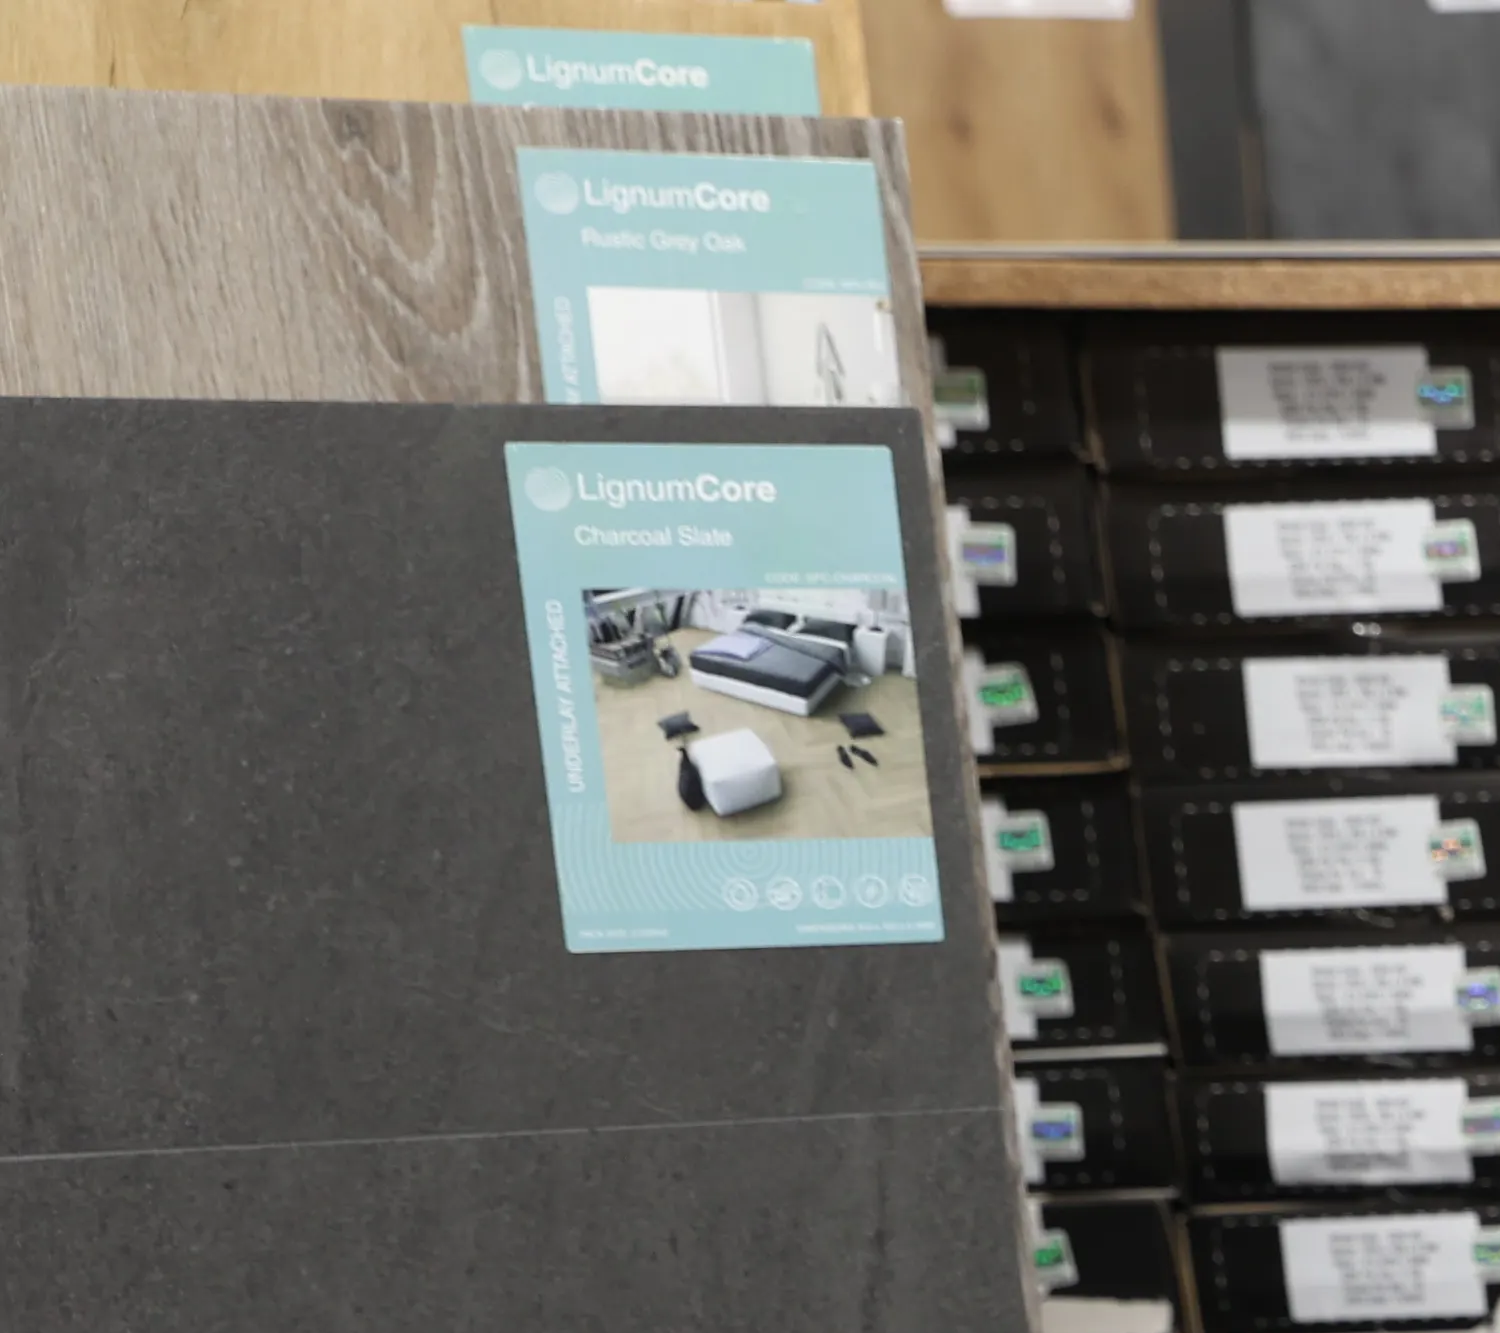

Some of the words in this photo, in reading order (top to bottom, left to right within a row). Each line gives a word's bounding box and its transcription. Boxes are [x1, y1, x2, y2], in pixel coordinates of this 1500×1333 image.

[526, 53, 709, 90] LignumCore
[584, 177, 771, 214] LignumCore
[702, 231, 747, 253] Oak
[577, 472, 777, 509] LignumCore
[574, 524, 672, 546] Charcoal
[678, 525, 733, 547] Slate
[545, 598, 572, 693] ATTACHED
[557, 696, 586, 793] UNDERLAY
